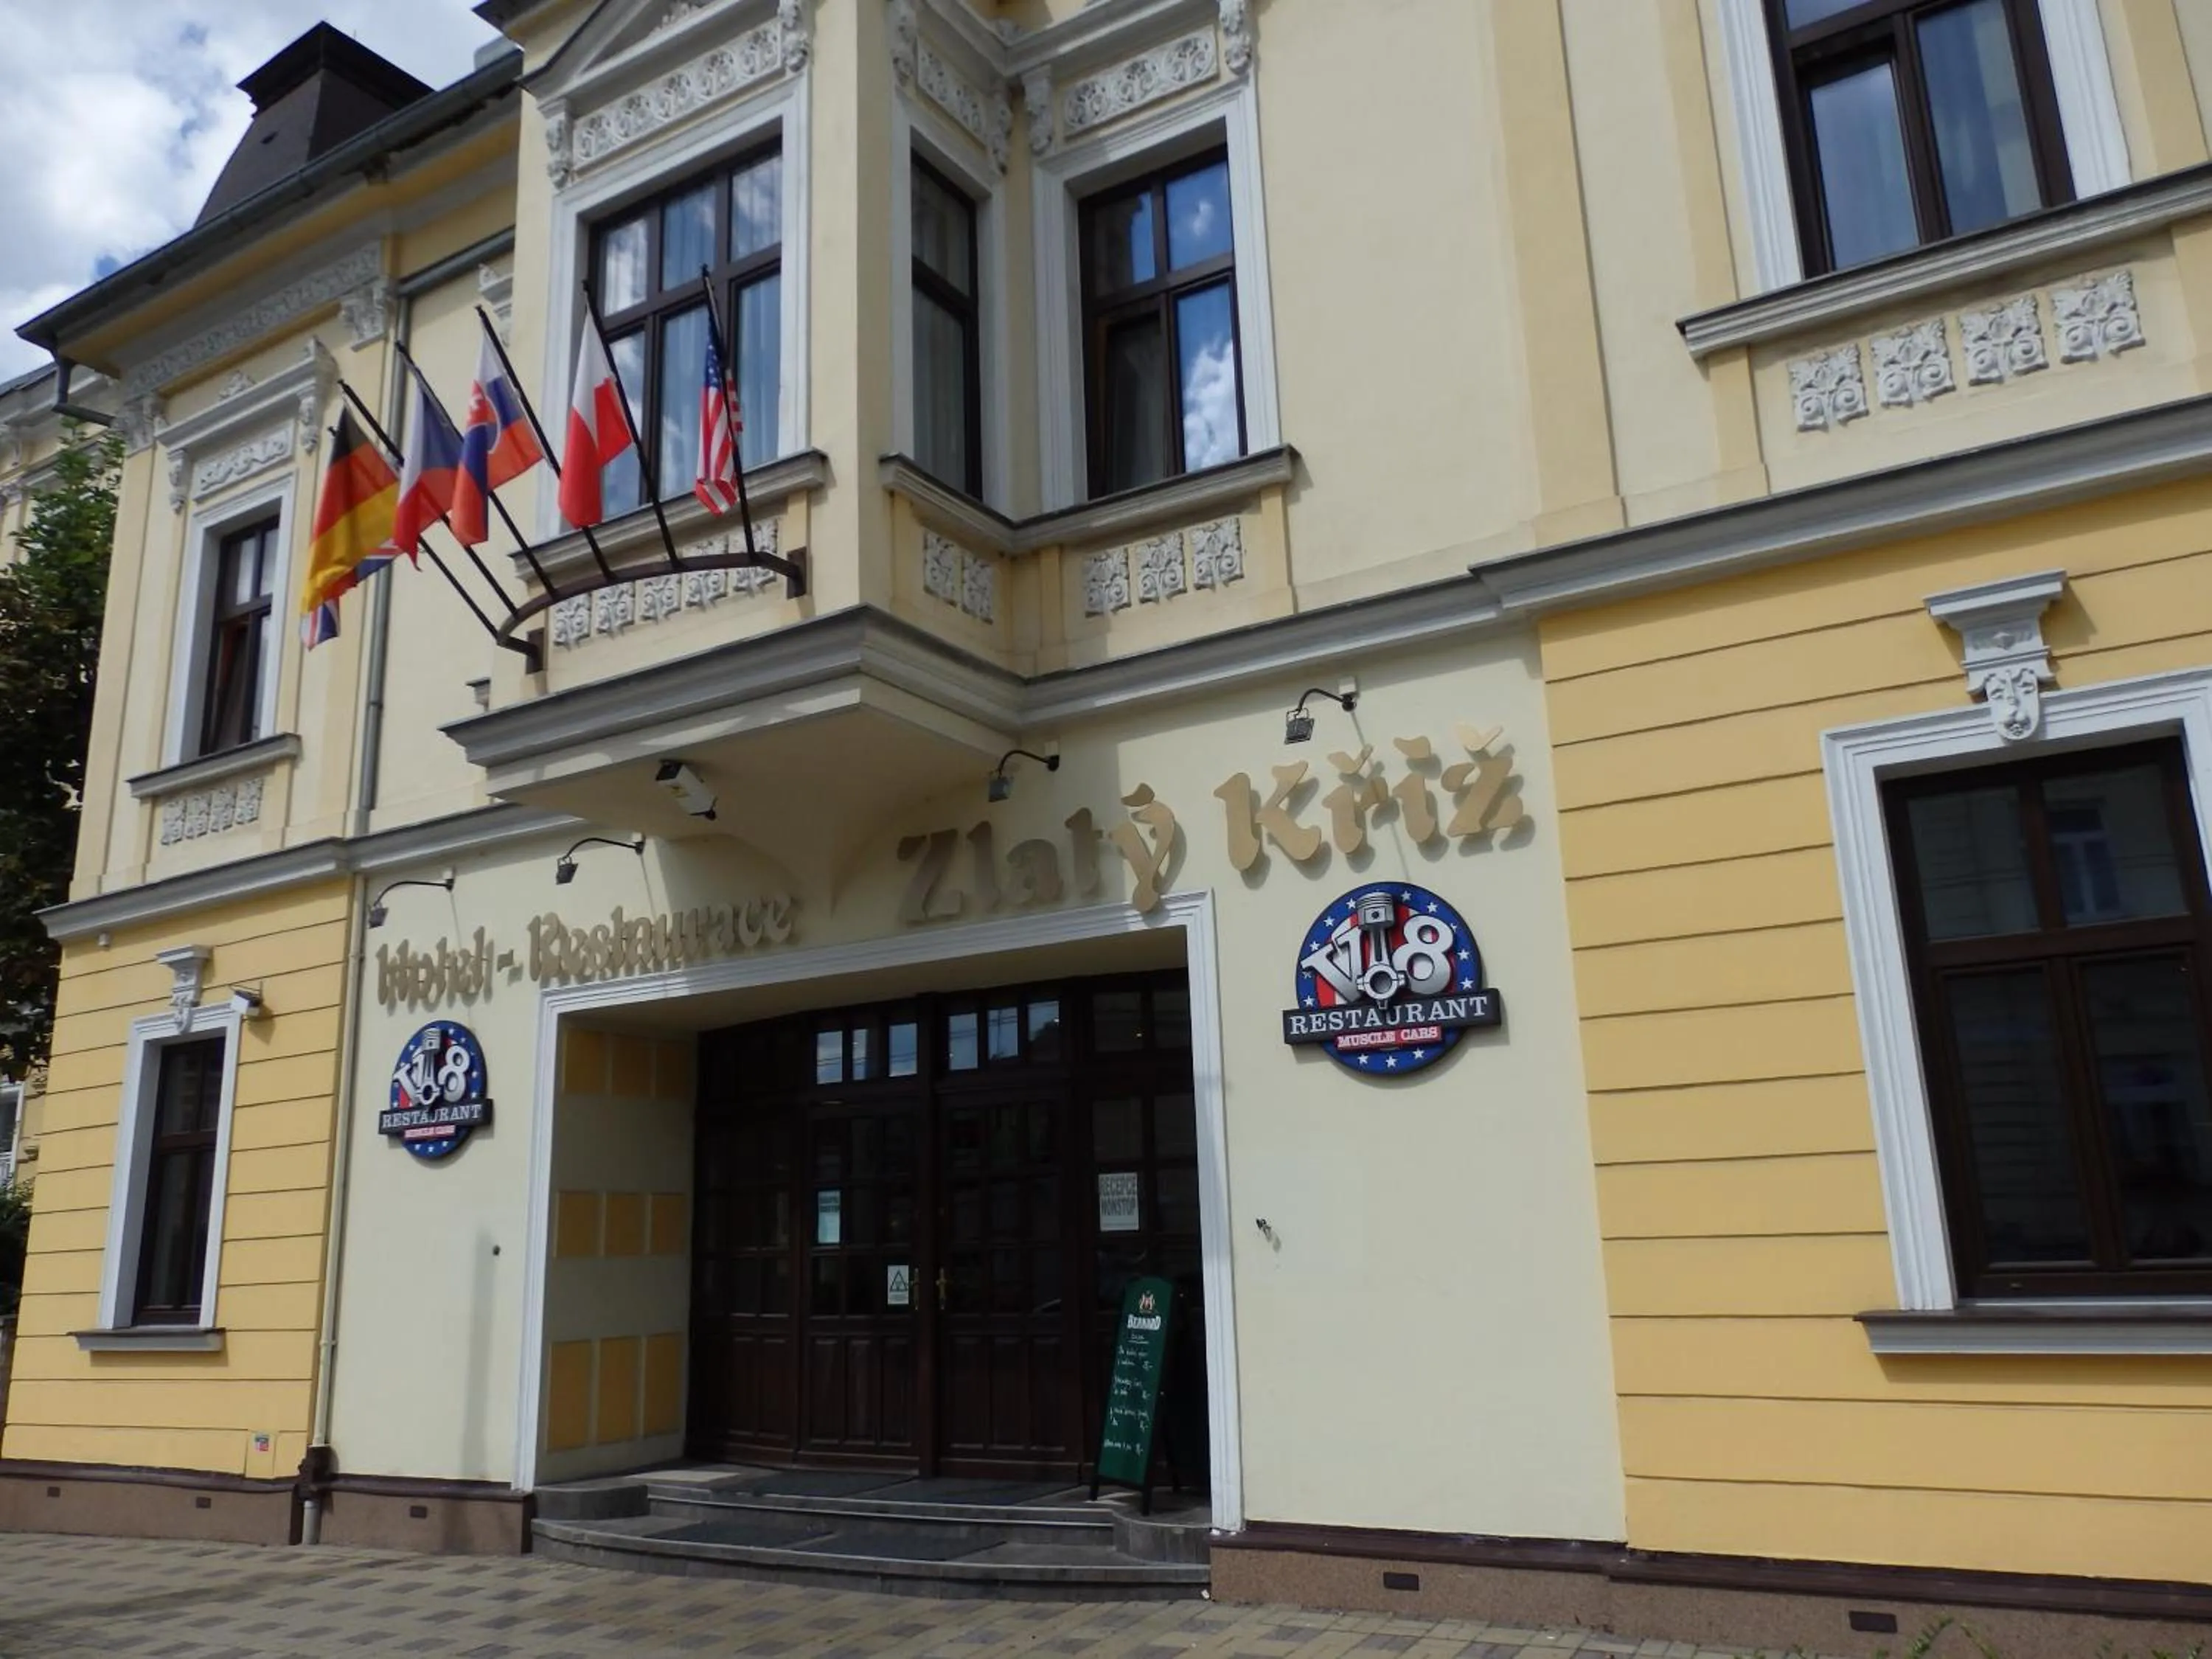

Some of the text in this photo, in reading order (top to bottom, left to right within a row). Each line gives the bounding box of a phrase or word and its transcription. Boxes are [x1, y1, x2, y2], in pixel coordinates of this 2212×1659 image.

[527, 891, 793, 981] Restaurace
[897, 783, 1175, 925] Zlatý
[1214, 725, 1523, 871] Kříž
[1290, 996, 1487, 1034] RESTAURANT
[1337, 1026, 1439, 1048] MUSCLE CARS
[382, 1105, 481, 1128] RESTAURANT
